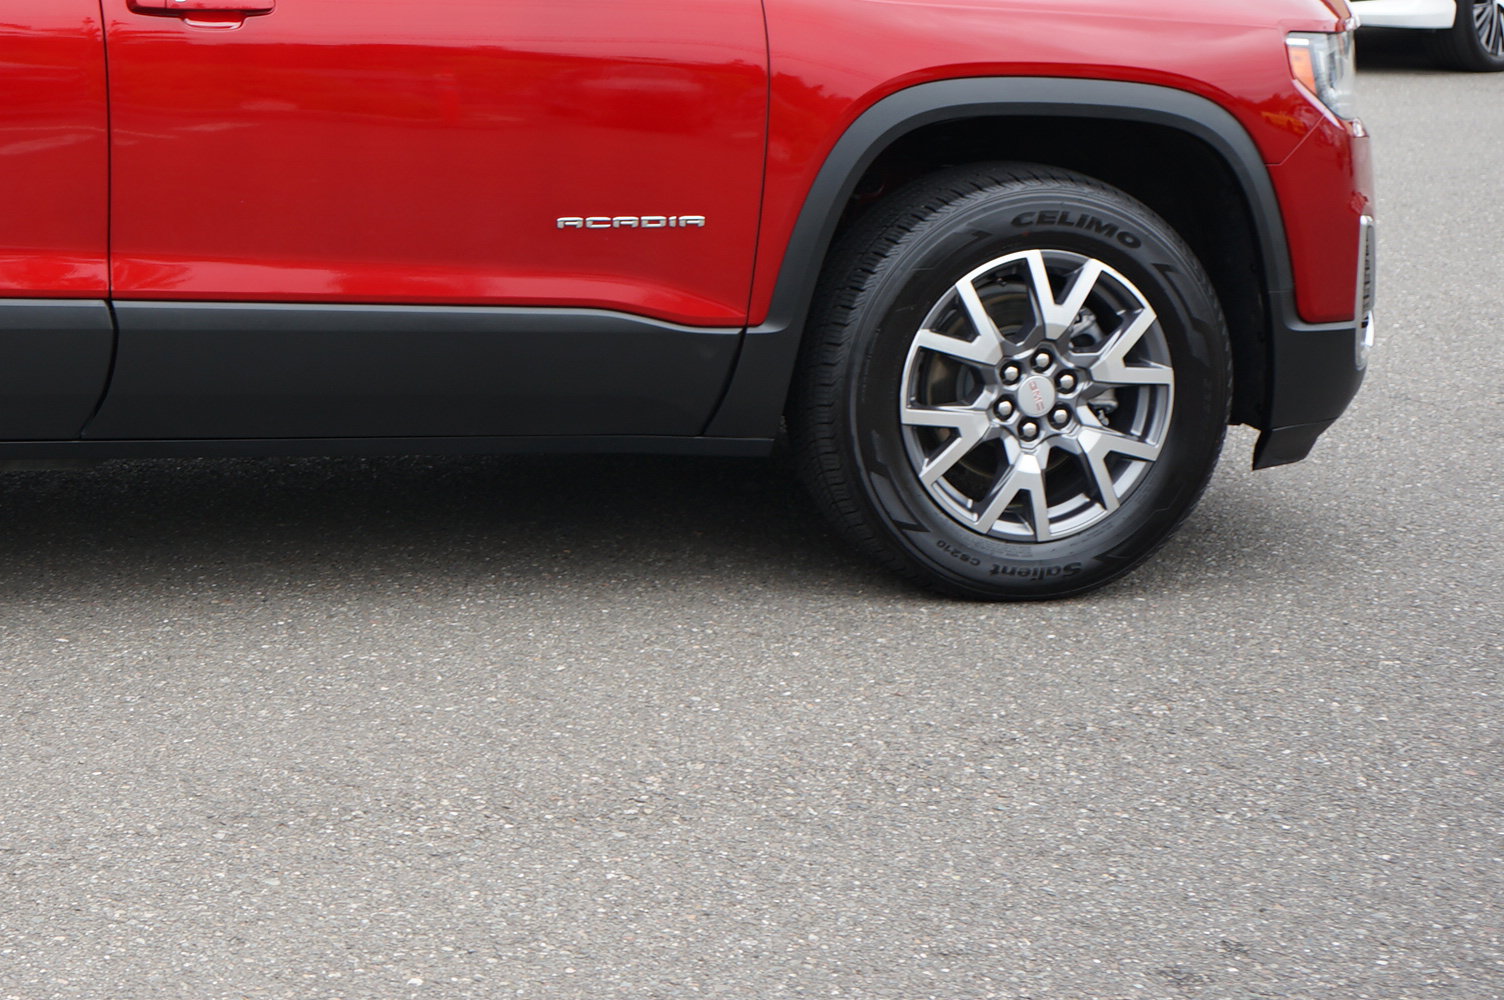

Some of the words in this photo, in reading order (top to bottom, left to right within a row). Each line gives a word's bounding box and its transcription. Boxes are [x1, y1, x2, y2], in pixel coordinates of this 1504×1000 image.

[556, 215, 706, 229] ACADIA
[1010, 209, 1142, 249] CELIMO
[989, 561, 1083, 581] Salient
